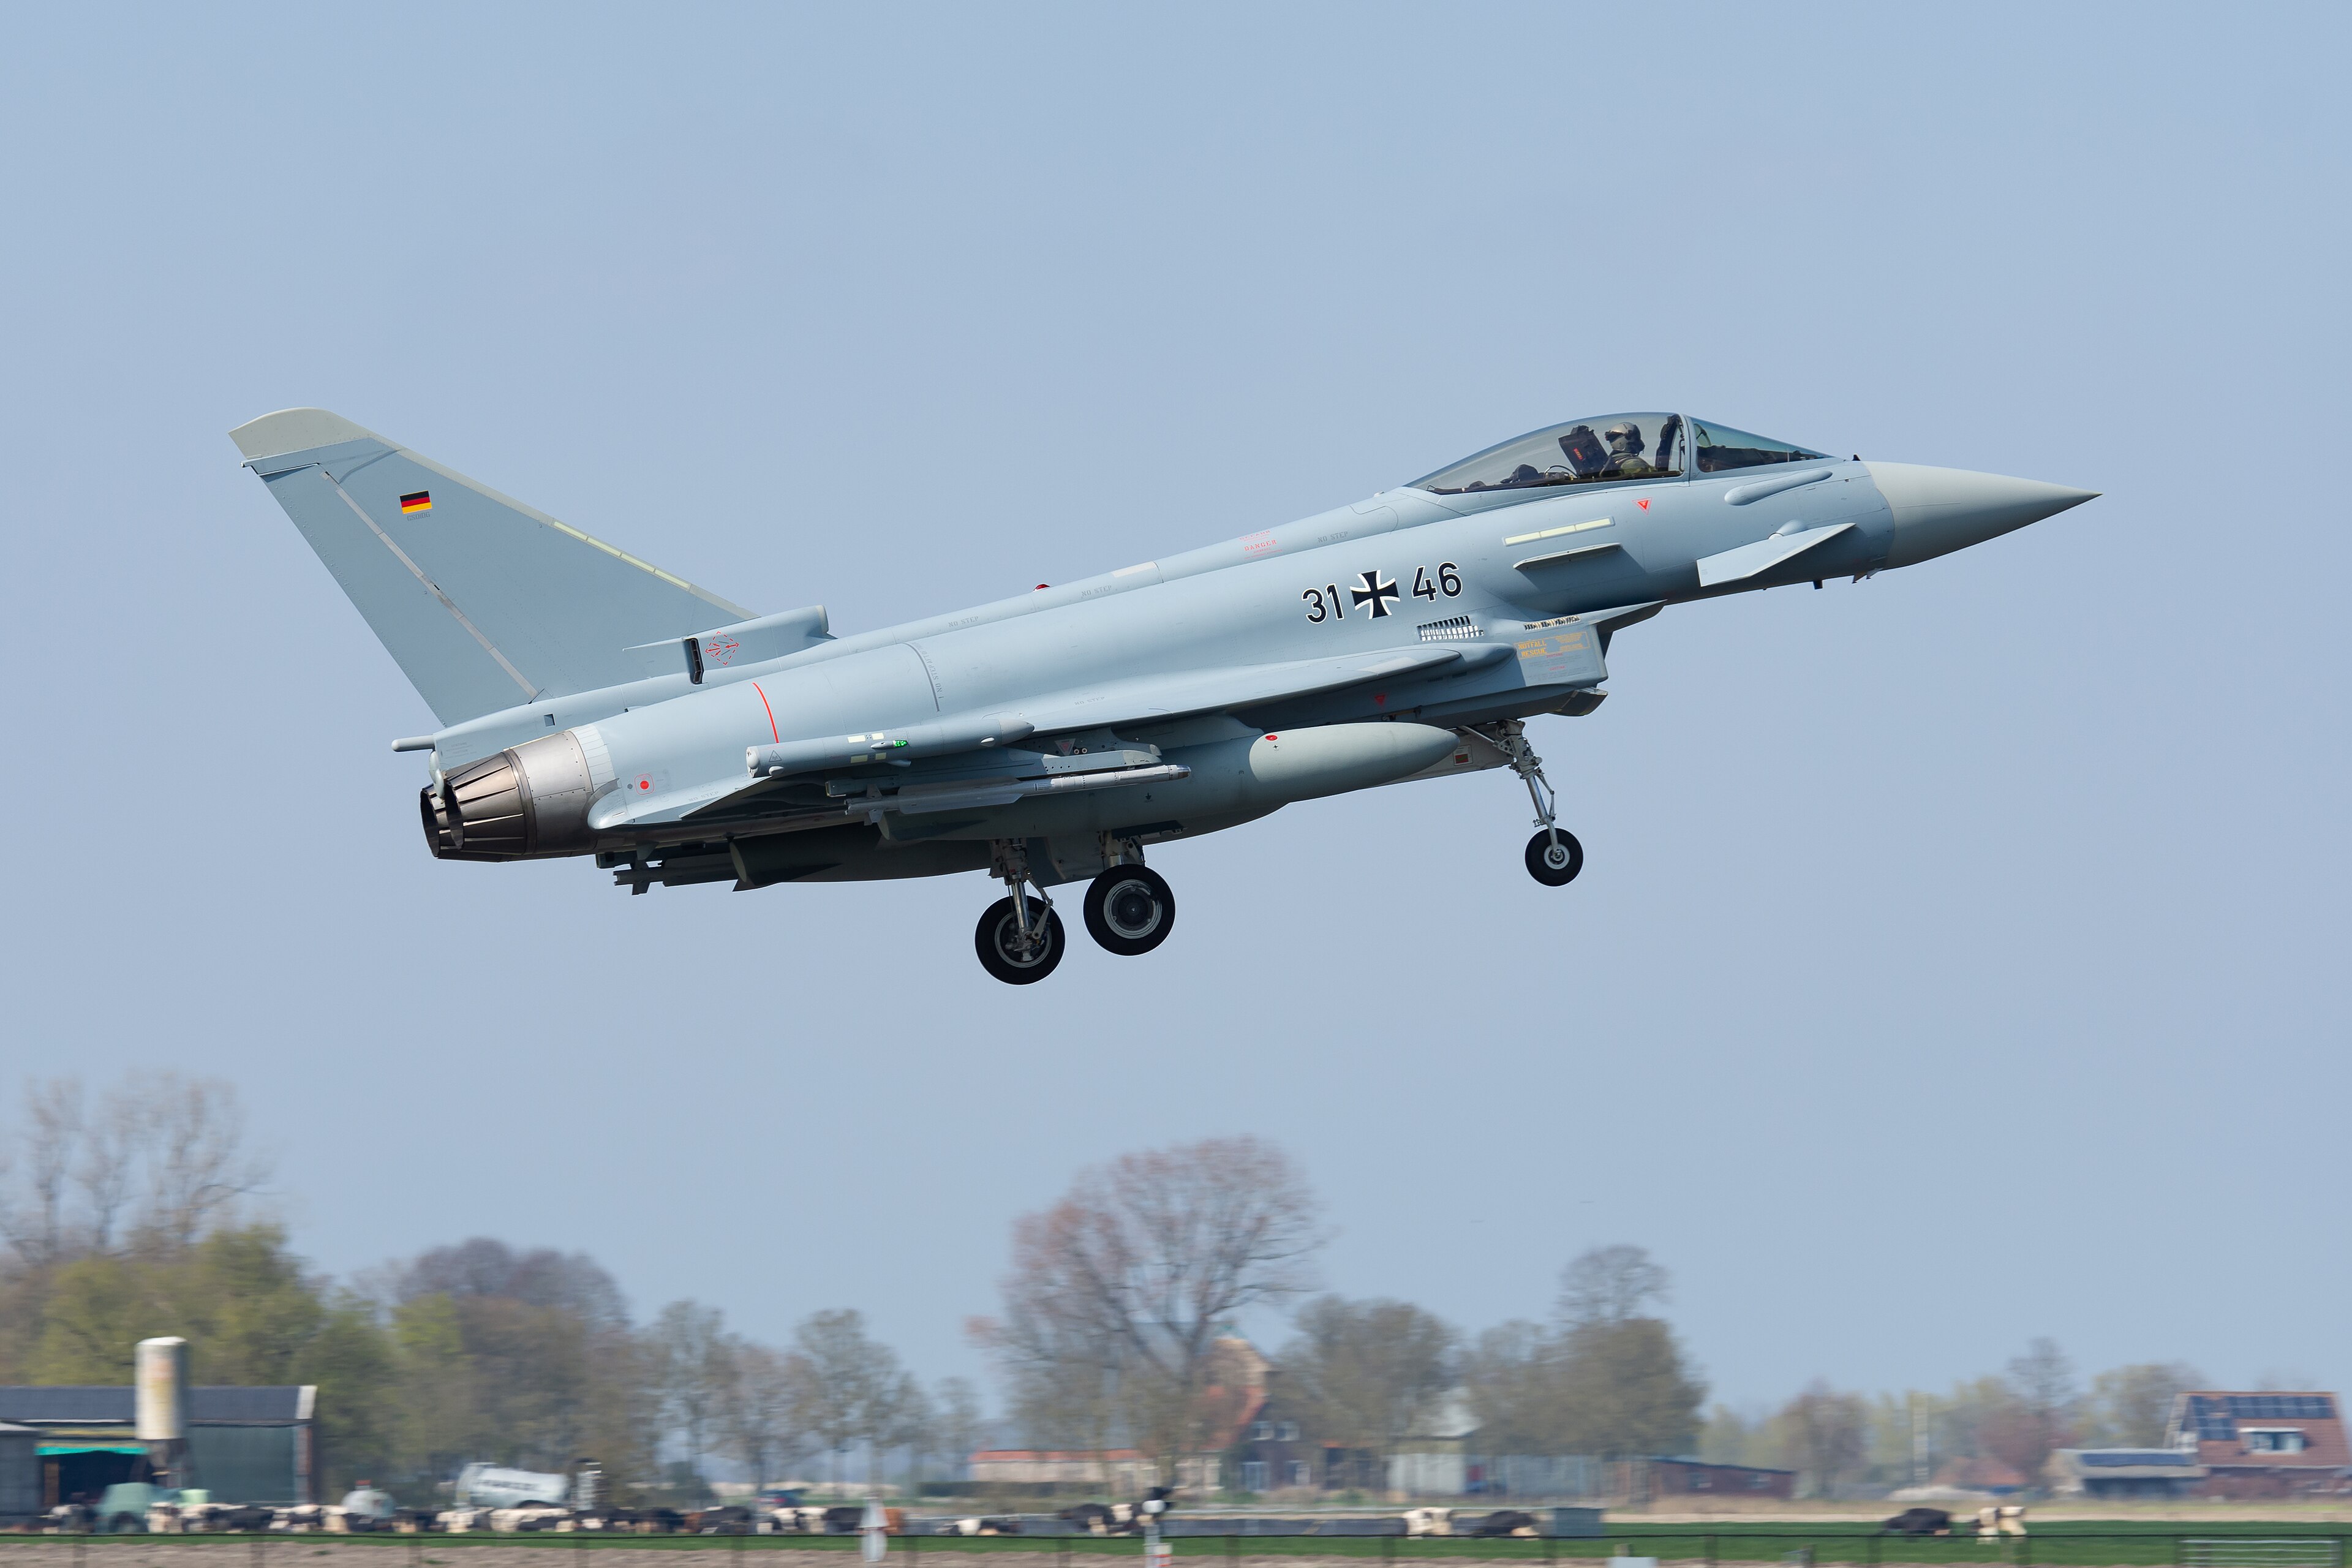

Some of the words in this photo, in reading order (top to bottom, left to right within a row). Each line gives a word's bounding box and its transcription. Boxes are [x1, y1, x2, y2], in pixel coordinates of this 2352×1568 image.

[1330, 531, 1348, 540] STEP
[1244, 539, 1277, 551] DANGER
[1094, 585, 1112, 594] STEP
[1301, 583, 1344, 624] 31
[1411, 561, 1463, 603] 46
[1518, 639, 1547, 650] NOTFALL
[1521, 647, 1547, 658] RESCUE
